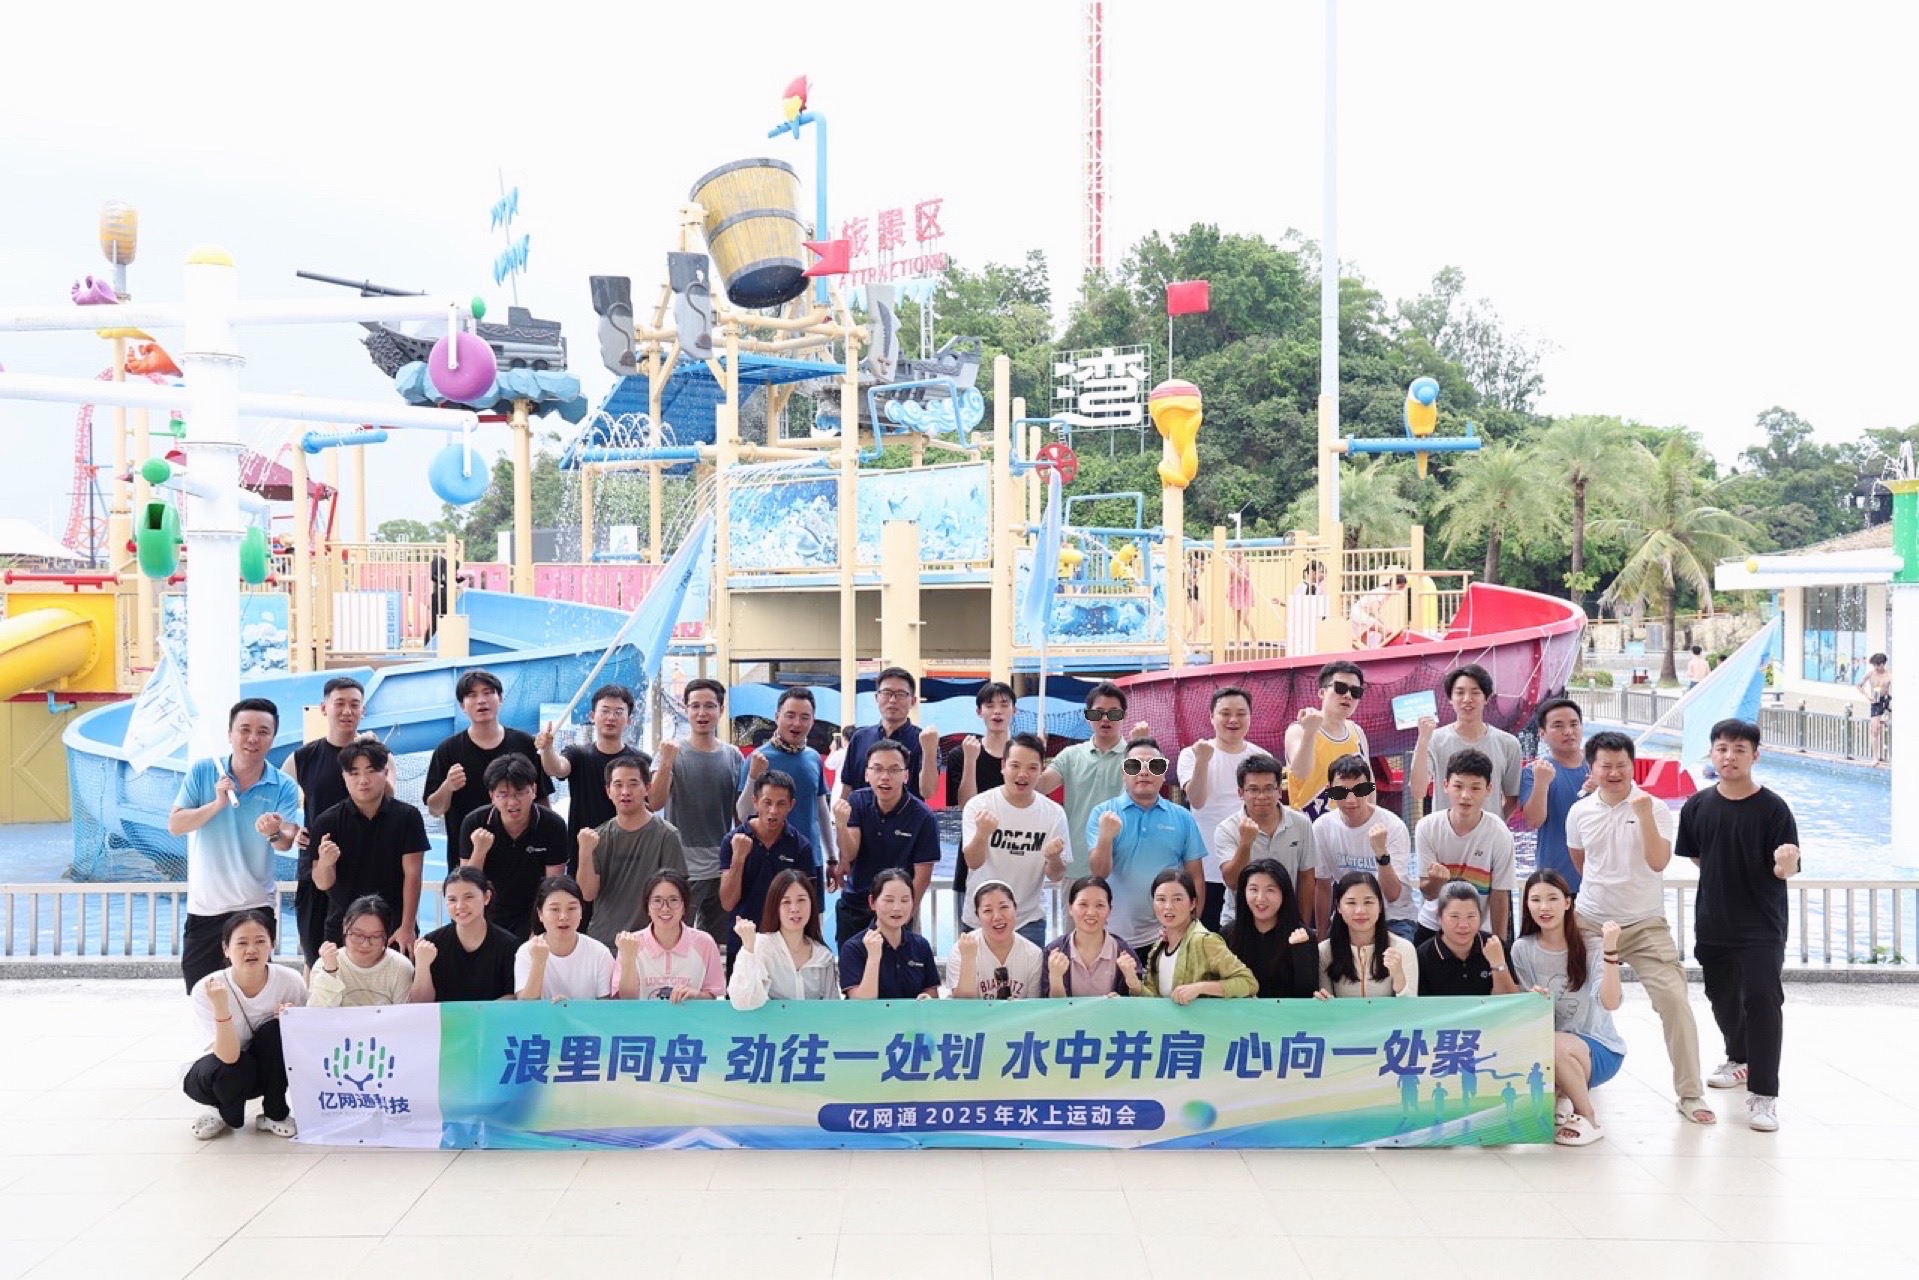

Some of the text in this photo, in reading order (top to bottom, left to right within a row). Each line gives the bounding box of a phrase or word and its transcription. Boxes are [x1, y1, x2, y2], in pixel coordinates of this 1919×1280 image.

[1050, 347, 1150, 432] 湾
[499, 1029, 1482, 1085] 浪里同舟 劲往一处划 水中并肩 心向一处聚
[318, 1091, 411, 1114] 亿网通科技
